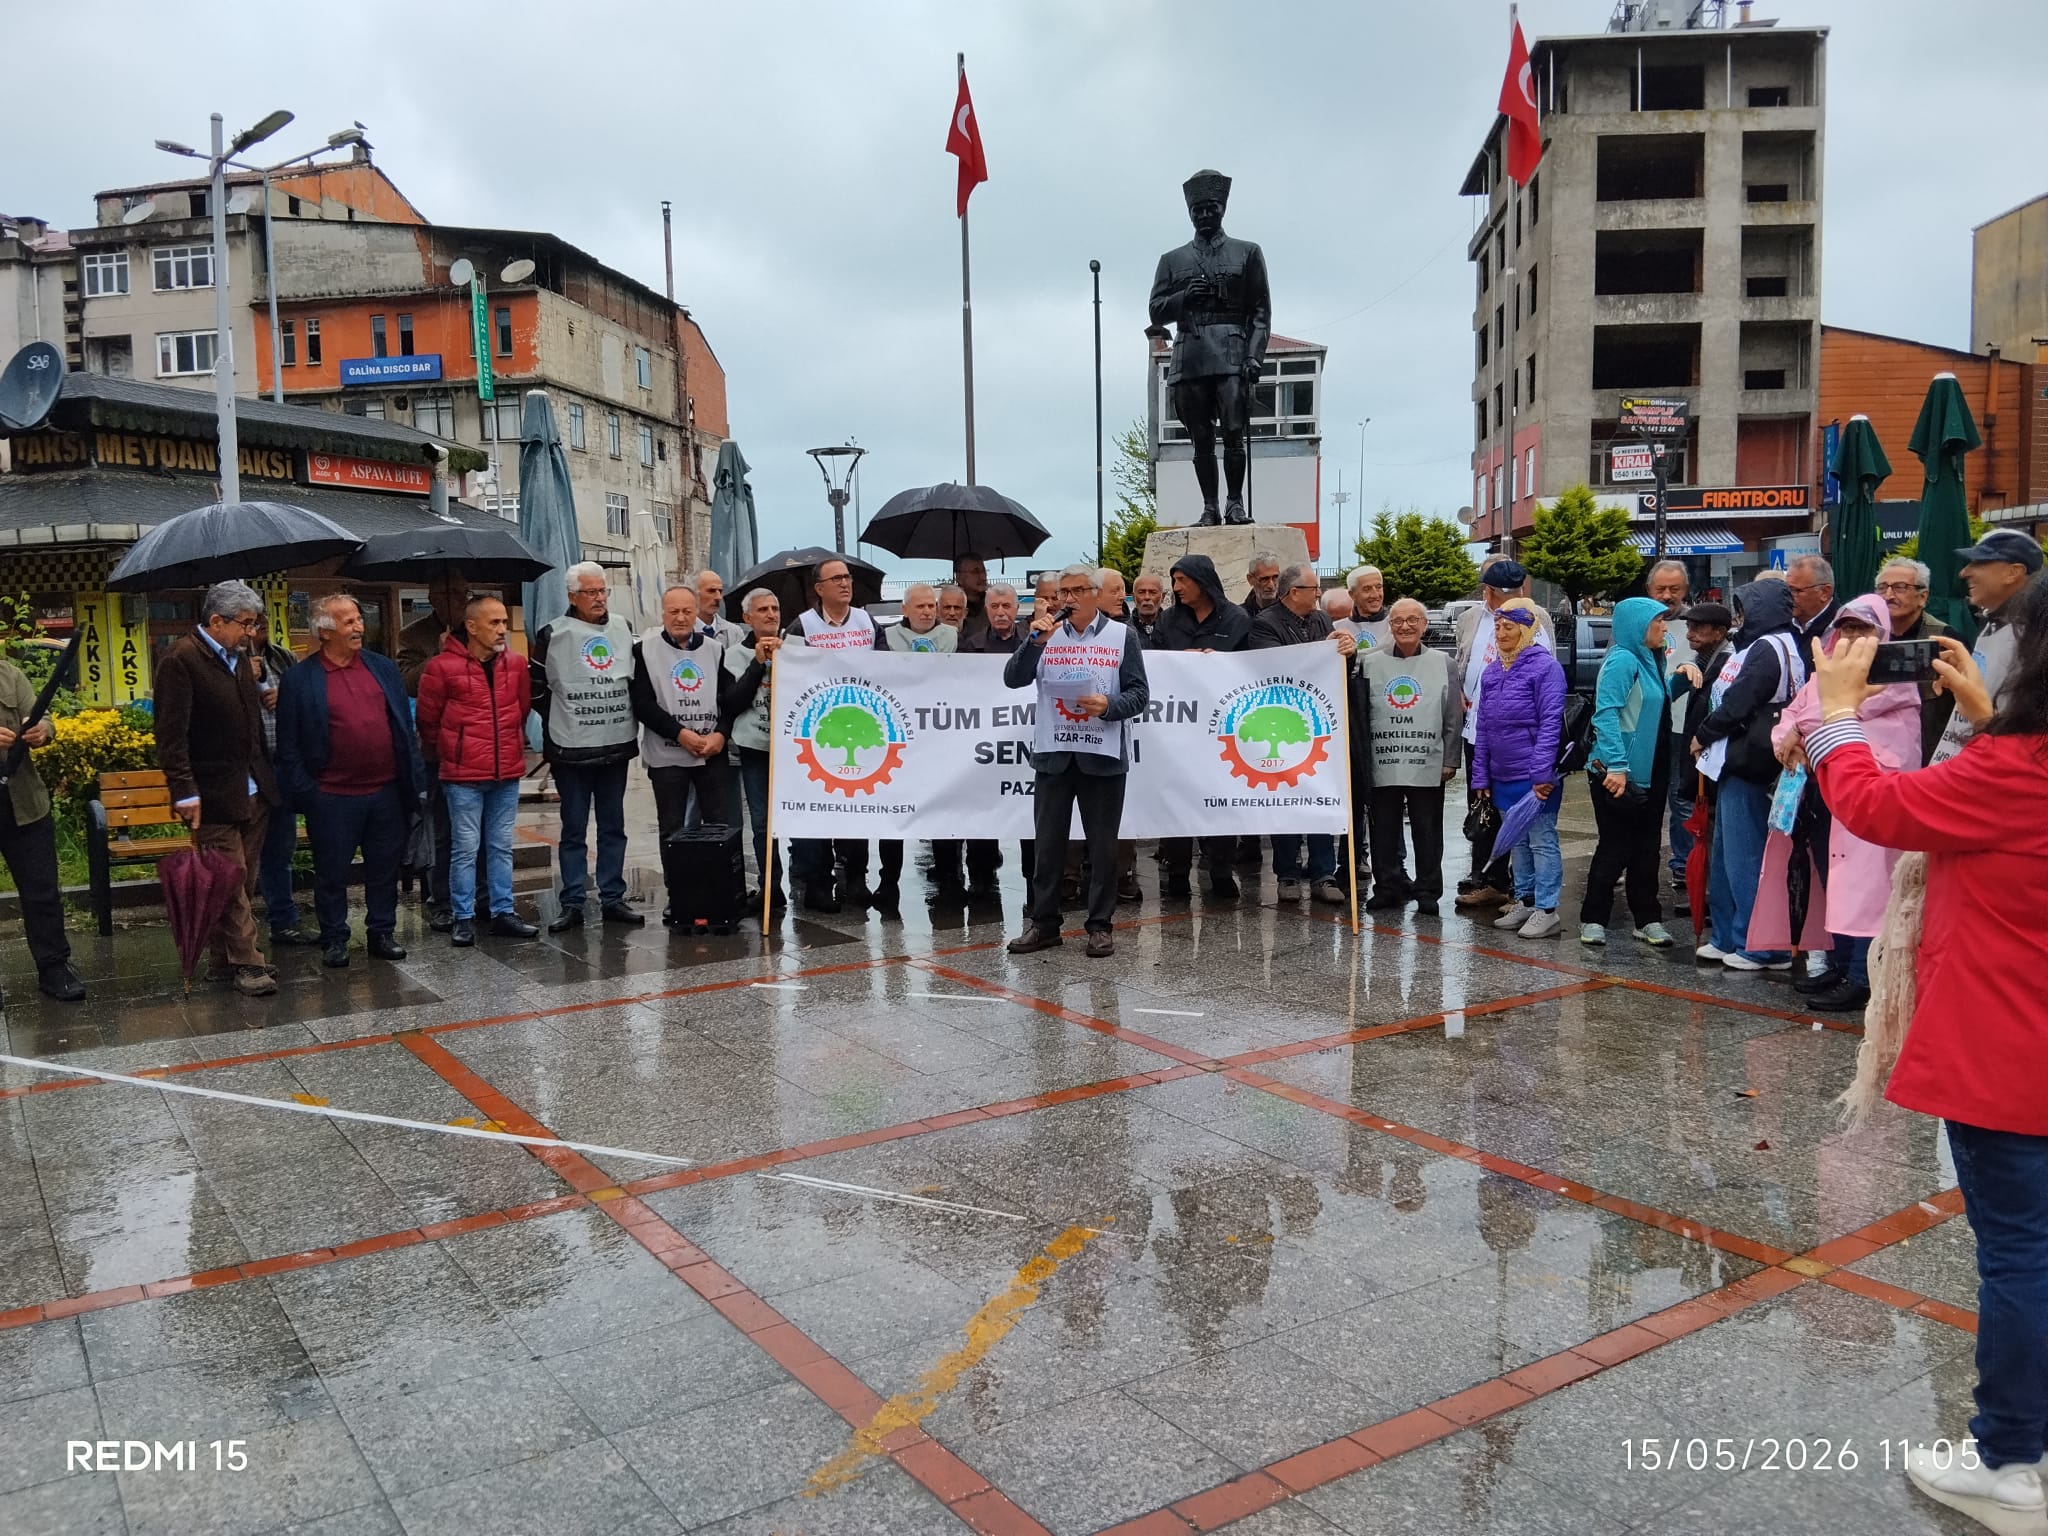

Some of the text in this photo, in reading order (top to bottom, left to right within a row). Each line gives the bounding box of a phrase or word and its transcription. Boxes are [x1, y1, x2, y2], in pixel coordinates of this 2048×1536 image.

[383, 364, 410, 374] DISCO
[412, 363, 431, 372] BAR
[96, 432, 294, 480] MEYDAN AKSİ
[1614, 455, 1652, 468] KİRALI
[350, 464, 424, 485] ASPAVA BÜFE
[1702, 489, 1805, 508] FIRATBORU
[274, 602, 283, 646] TAK
[1045, 645, 1087, 654] DEMOKRATİK
[1044, 656, 1083, 665] İNSANCA
[590, 675, 614, 685] TÜM
[678, 697, 700, 706] TÜM
[784, 710, 797, 736] TÜM
[795, 677, 871, 708] EMEKLİLERİN
[1208, 709, 1220, 735] TÜM
[1220, 675, 1293, 705] EMEKLİLERİN
[575, 704, 627, 715] SENDİKAS
[915, 702, 981, 730] TÜM
[1390, 713, 1414, 724] TÜM
[1375, 743, 1430, 754] SENDİKASI
[838, 767, 861, 775] 2017
[1000, 781, 1035, 796] PAZ
[781, 800, 915, 814] TÜM EMEKLİLERİN-SEN
[1204, 795, 1340, 807] TÜM EMEKLİLERİN-SEN
